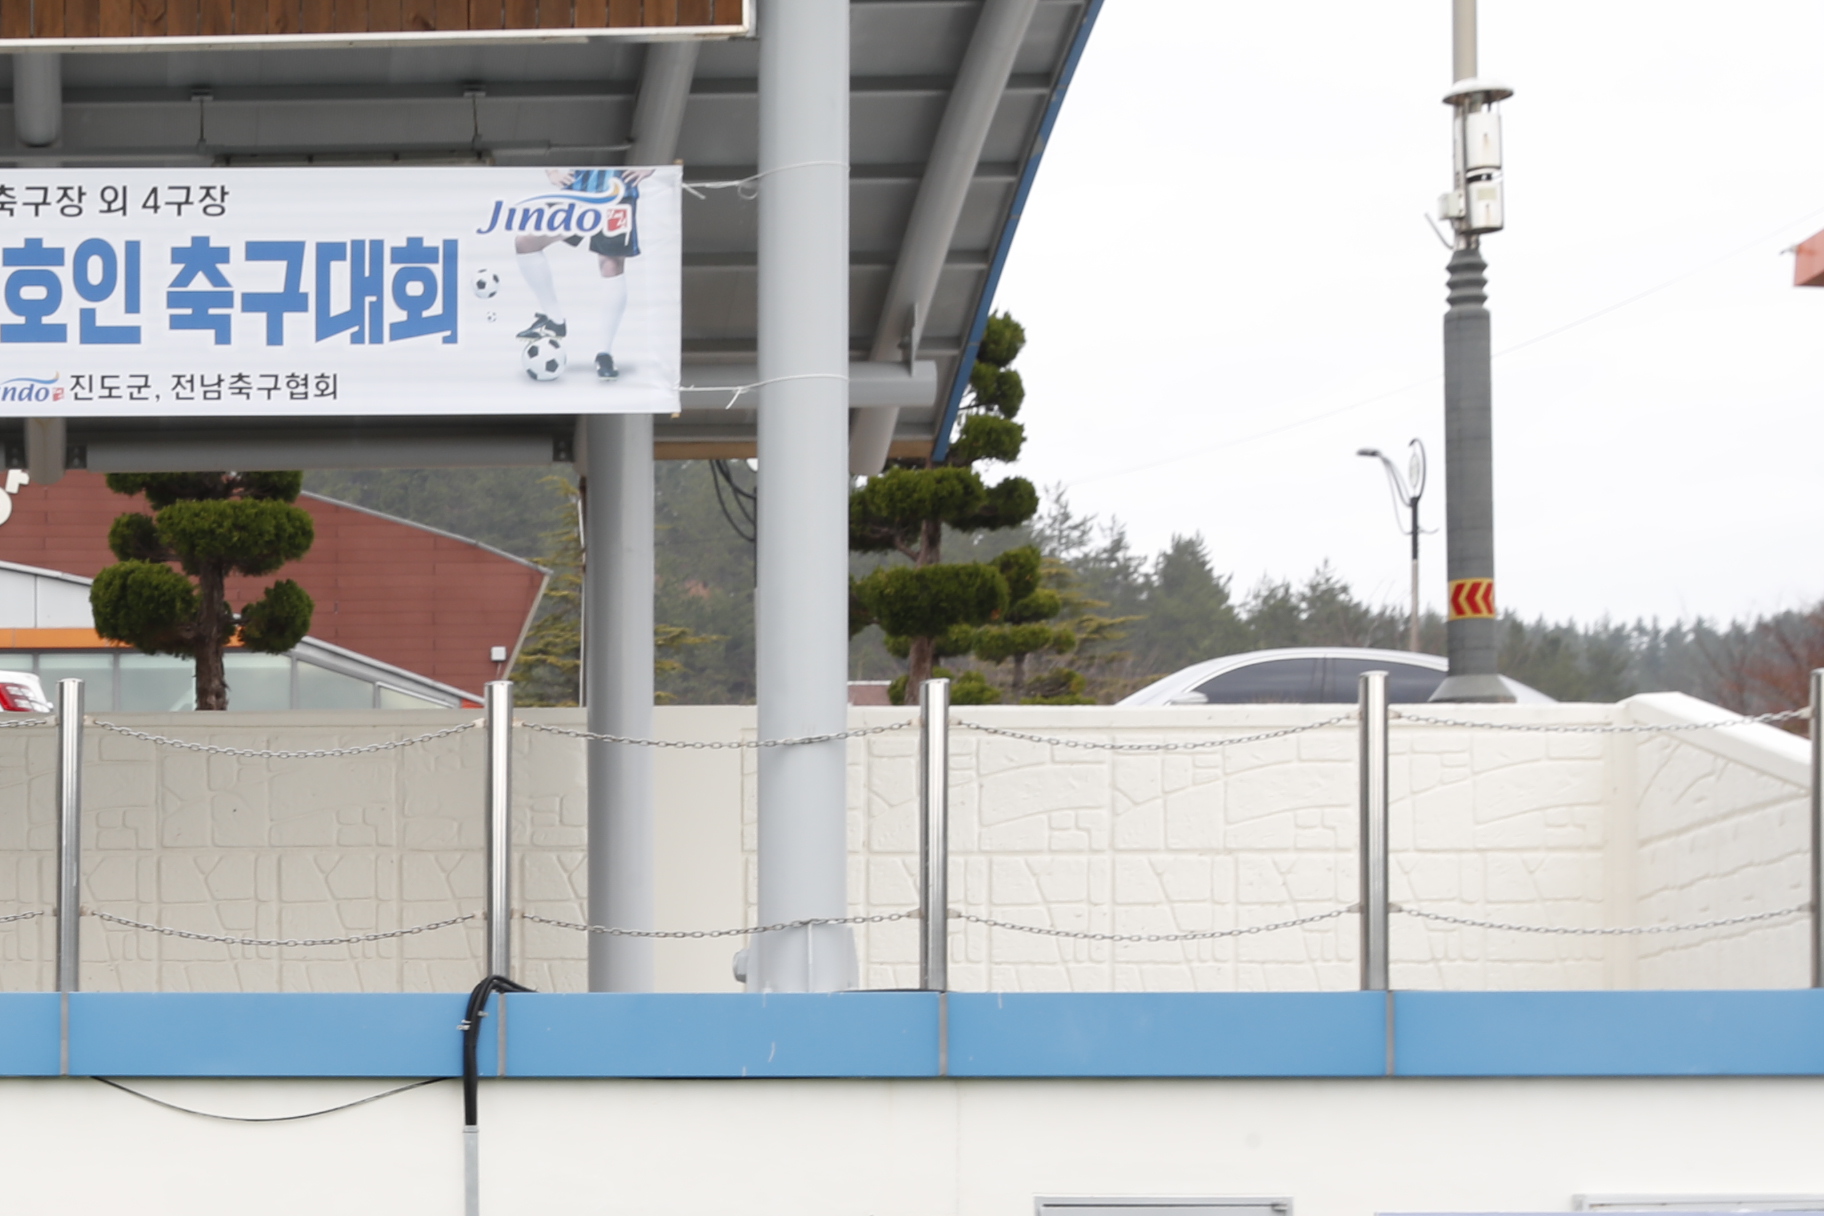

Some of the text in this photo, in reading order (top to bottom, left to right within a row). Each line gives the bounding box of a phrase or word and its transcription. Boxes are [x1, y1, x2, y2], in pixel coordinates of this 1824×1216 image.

[99, 184, 129, 217] 외
[141, 184, 230, 217] 4구장
[476, 200, 603, 234] Jindo
[166, 235, 459, 346] 축구대회
[69, 373, 162, 403] 진도군,
[169, 372, 339, 402] 전남축구협회
